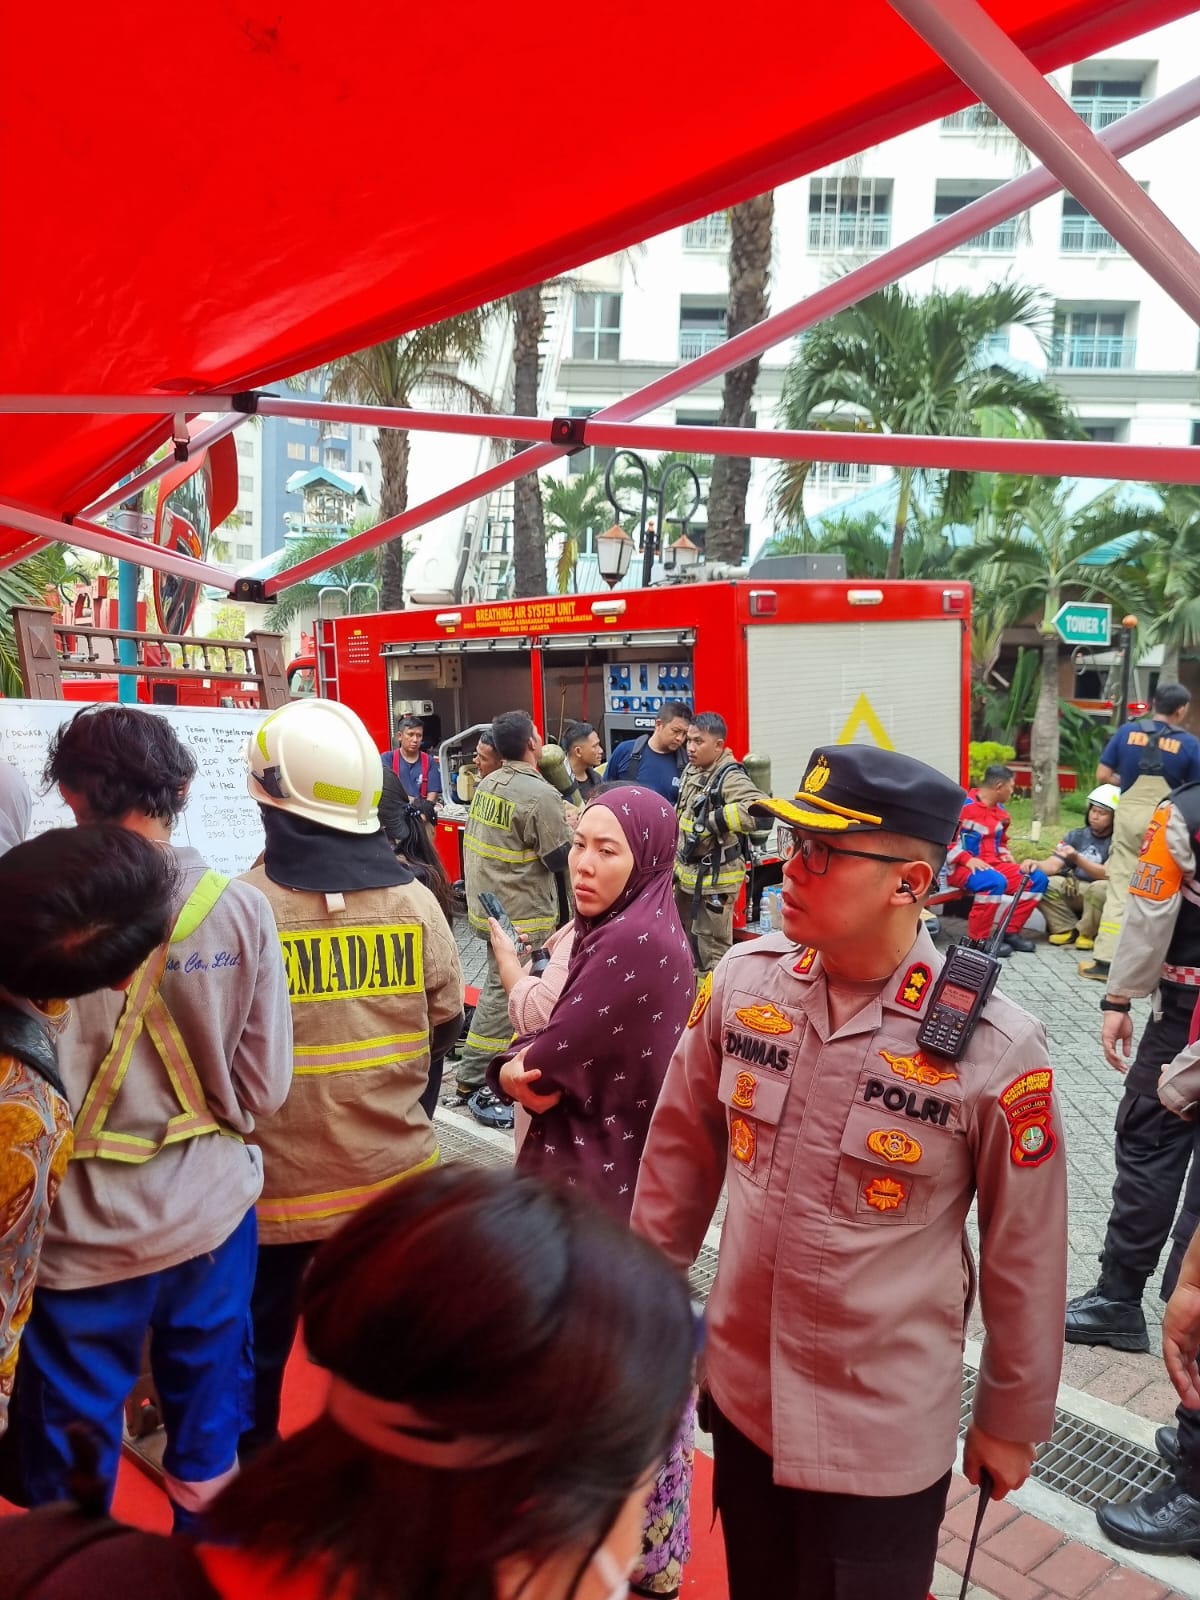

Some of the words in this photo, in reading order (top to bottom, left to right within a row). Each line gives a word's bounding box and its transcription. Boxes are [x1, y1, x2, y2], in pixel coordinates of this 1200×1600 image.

[475, 607, 513, 622] BREATHING
[514, 605, 526, 619] AIR
[527, 603, 556, 618] SYSTEM
[557, 601, 576, 615] UNIT
[1065, 614, 1099, 634] TOWER
[1101, 617, 1106, 634] 1
[281, 932, 417, 995] EMADAM
[724, 1031, 789, 1072] DHIMAS
[863, 1078, 952, 1126] POLRI
